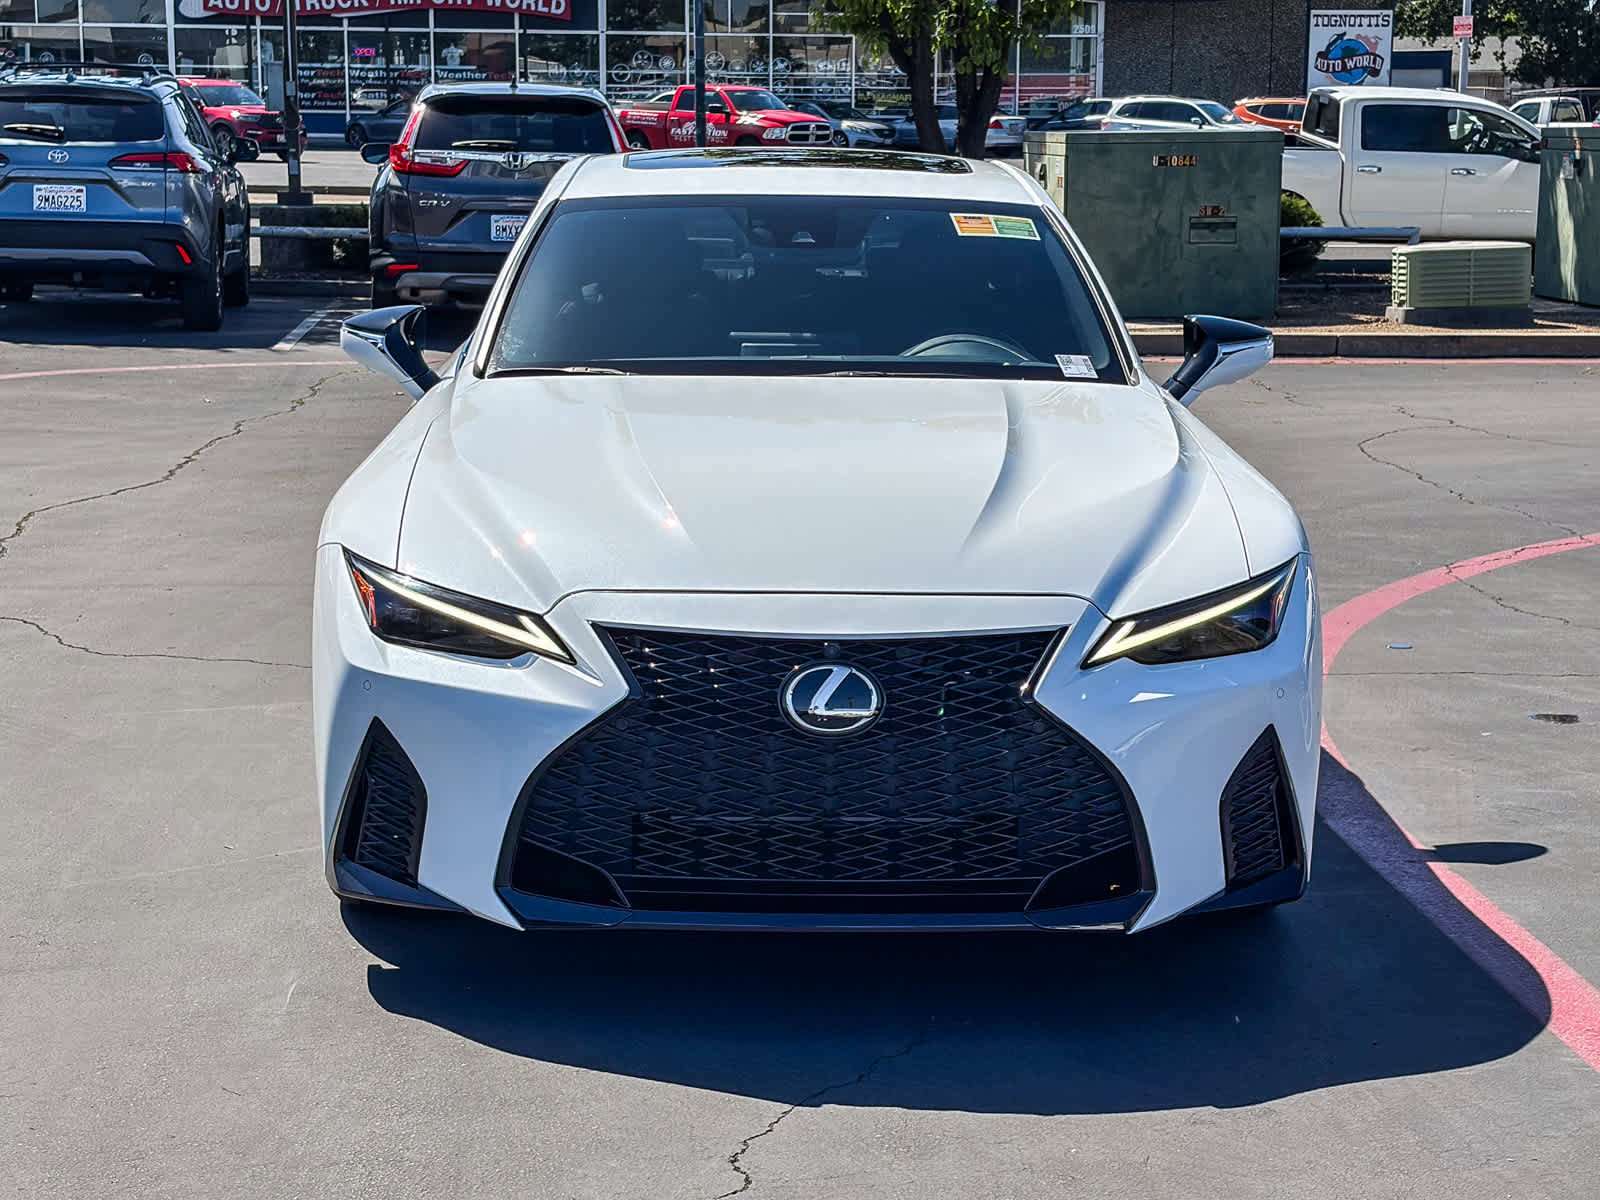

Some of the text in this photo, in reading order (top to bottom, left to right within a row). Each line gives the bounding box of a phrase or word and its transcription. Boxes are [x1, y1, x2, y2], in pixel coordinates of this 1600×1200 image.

[1313, 12, 1390, 27] TOGNOTTI'S
[355, 48, 375, 56] OPEN
[1316, 55, 1382, 71] AUTO WORLD
[437, 70, 513, 79] WeatherTech
[37, 194, 82, 208] 9MAG225
